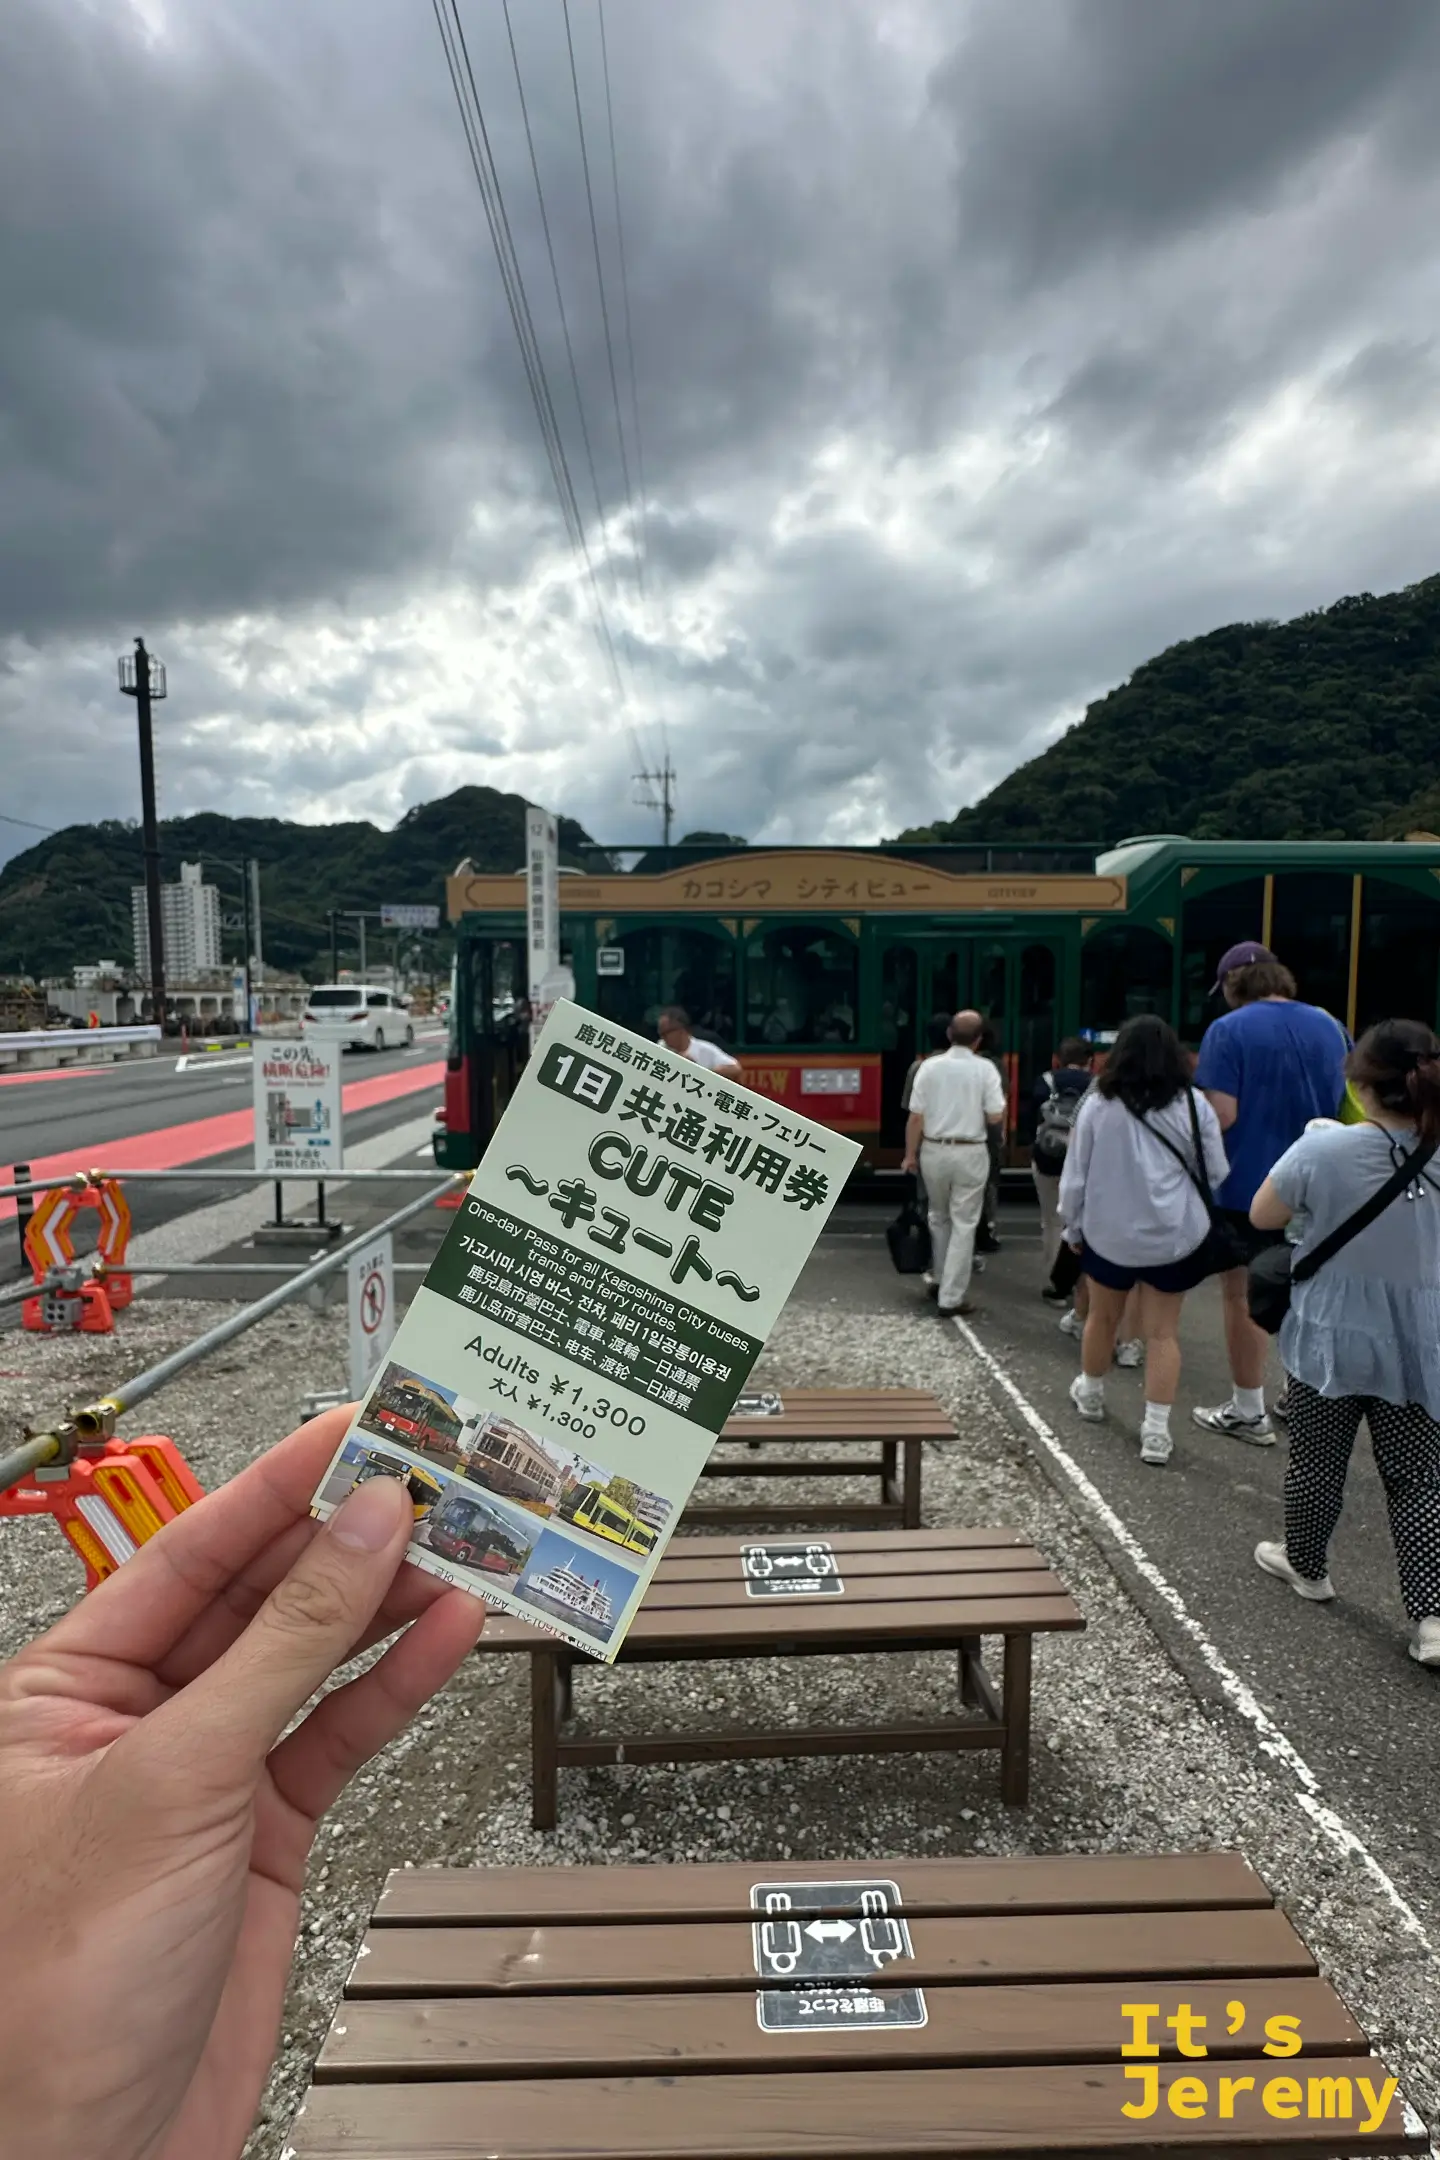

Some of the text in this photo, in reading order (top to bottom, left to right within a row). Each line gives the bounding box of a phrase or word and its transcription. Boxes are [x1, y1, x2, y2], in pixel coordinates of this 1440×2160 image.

[683, 879, 932, 899] カゴシマ シティビュー
[555, 1055, 828, 1211] 1日 共通利用券
[573, 1024, 826, 1153] 鹿児島市営バス・電車・フェリー
[588, 1131, 734, 1232] CUTE
[460, 1236, 731, 1381] 가고시마 시영 버스, 전차, 페리 1일공통이용권
[469, 1202, 749, 1354] One-day Pass for all Kagoshima City buses,
[528, 1249, 676, 1332] trams and ferry routes.
[464, 1336, 645, 1435] Adults ¥1,300
[489, 1378, 596, 1438] 大人 ¥1,300
[634, 1377, 693, 1411] 一日通票
[643, 1357, 702, 1391] 一日通票
